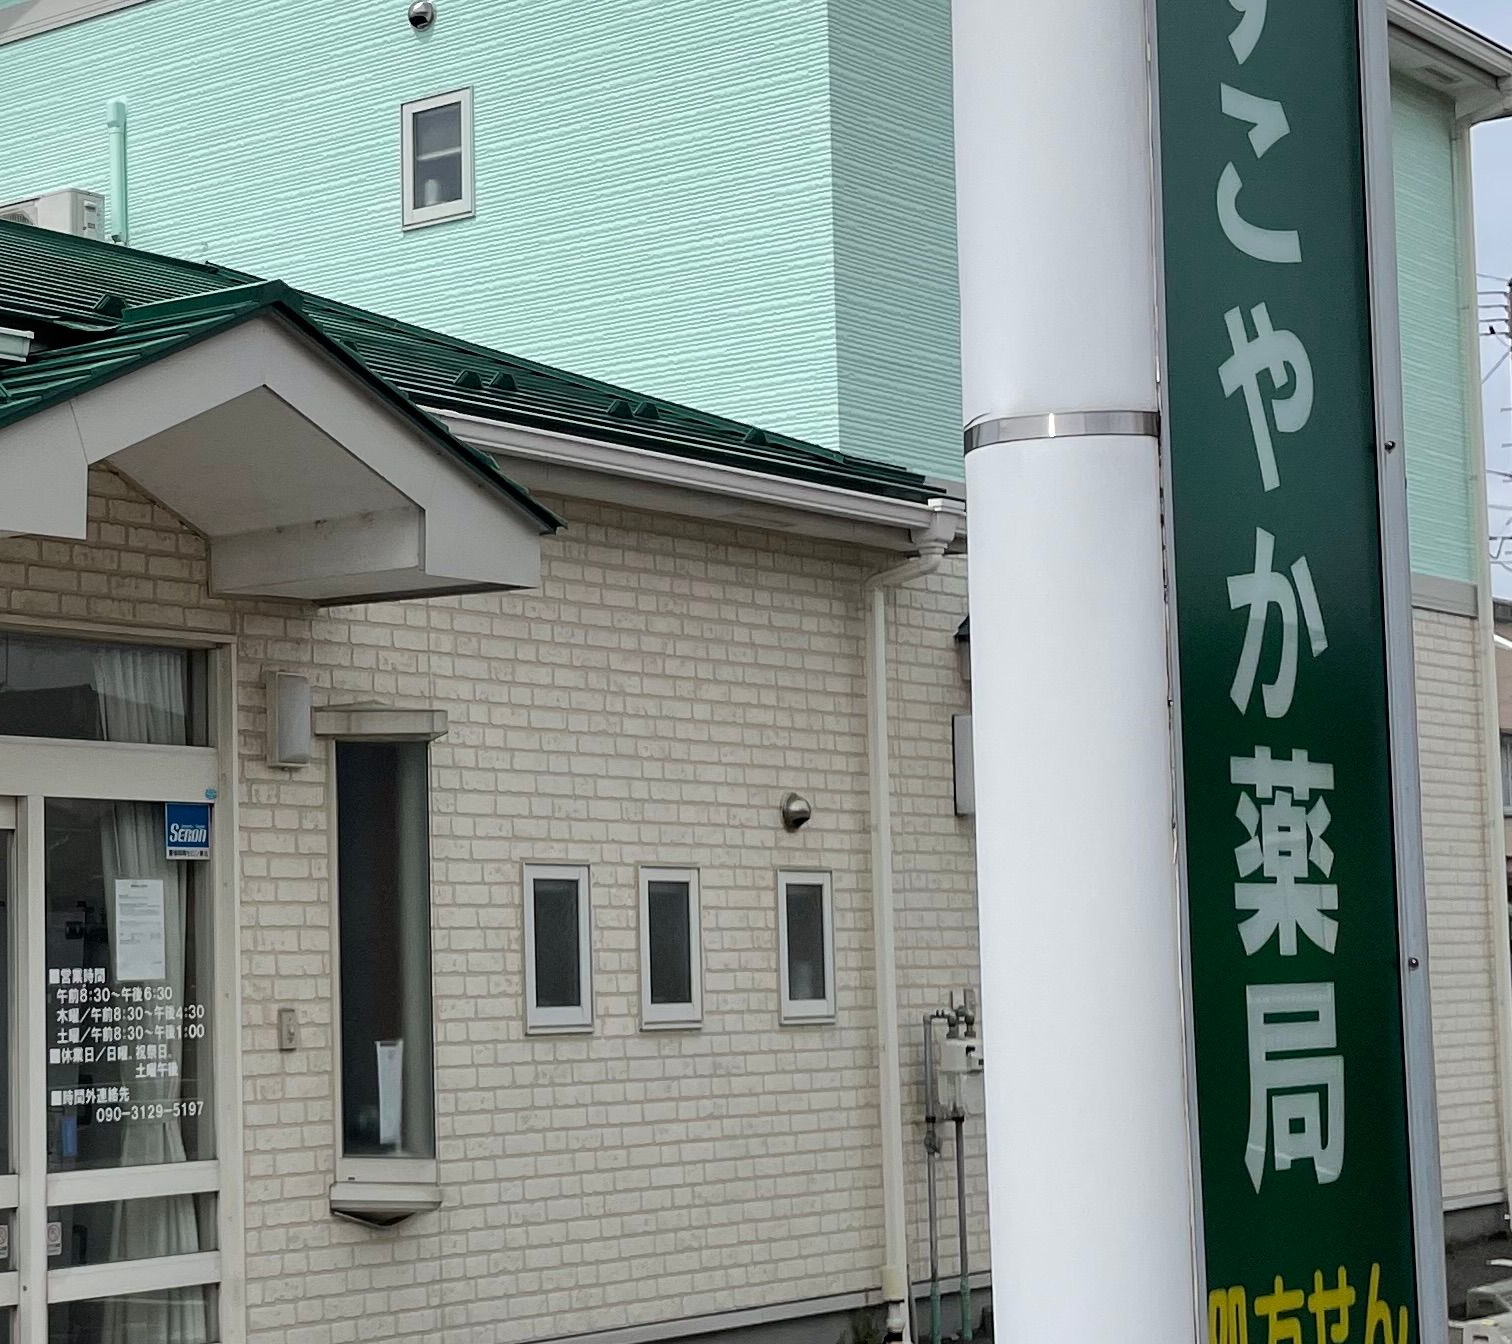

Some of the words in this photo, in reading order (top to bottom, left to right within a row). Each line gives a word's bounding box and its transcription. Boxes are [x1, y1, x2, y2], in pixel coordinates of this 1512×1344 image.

[60, 967, 106, 984] 営業時間
[135, 1061, 179, 1079] 土曜午後
[62, 1086, 131, 1106] 時間外連絡先
[95, 1101, 205, 1124] 090-3129-5197
